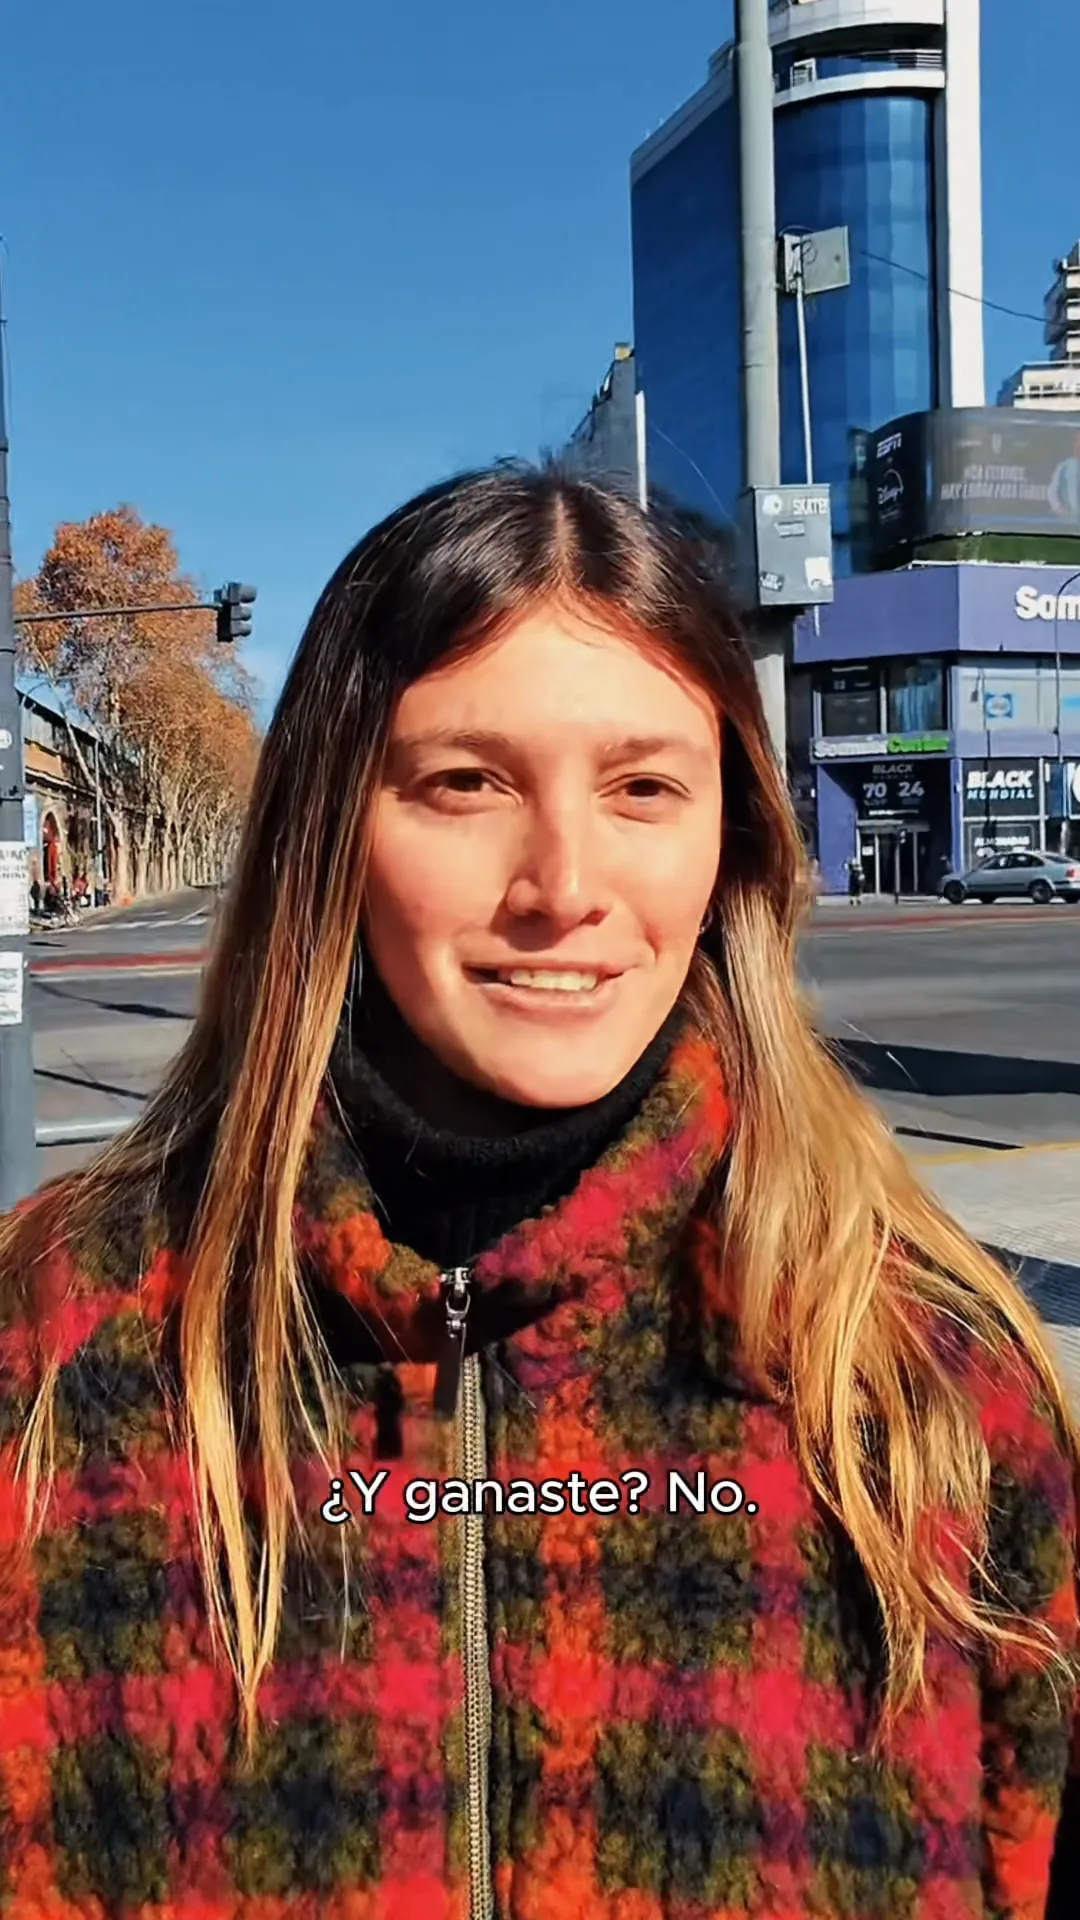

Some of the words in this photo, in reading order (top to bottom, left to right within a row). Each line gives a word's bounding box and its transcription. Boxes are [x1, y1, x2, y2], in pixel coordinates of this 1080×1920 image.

[872, 764, 914, 774] BLACK
[967, 770, 1035, 789] BLACK
[862, 782, 887, 799] 70
[898, 781, 925, 797] 24
[967, 788, 1035, 800] MUNDIAL
